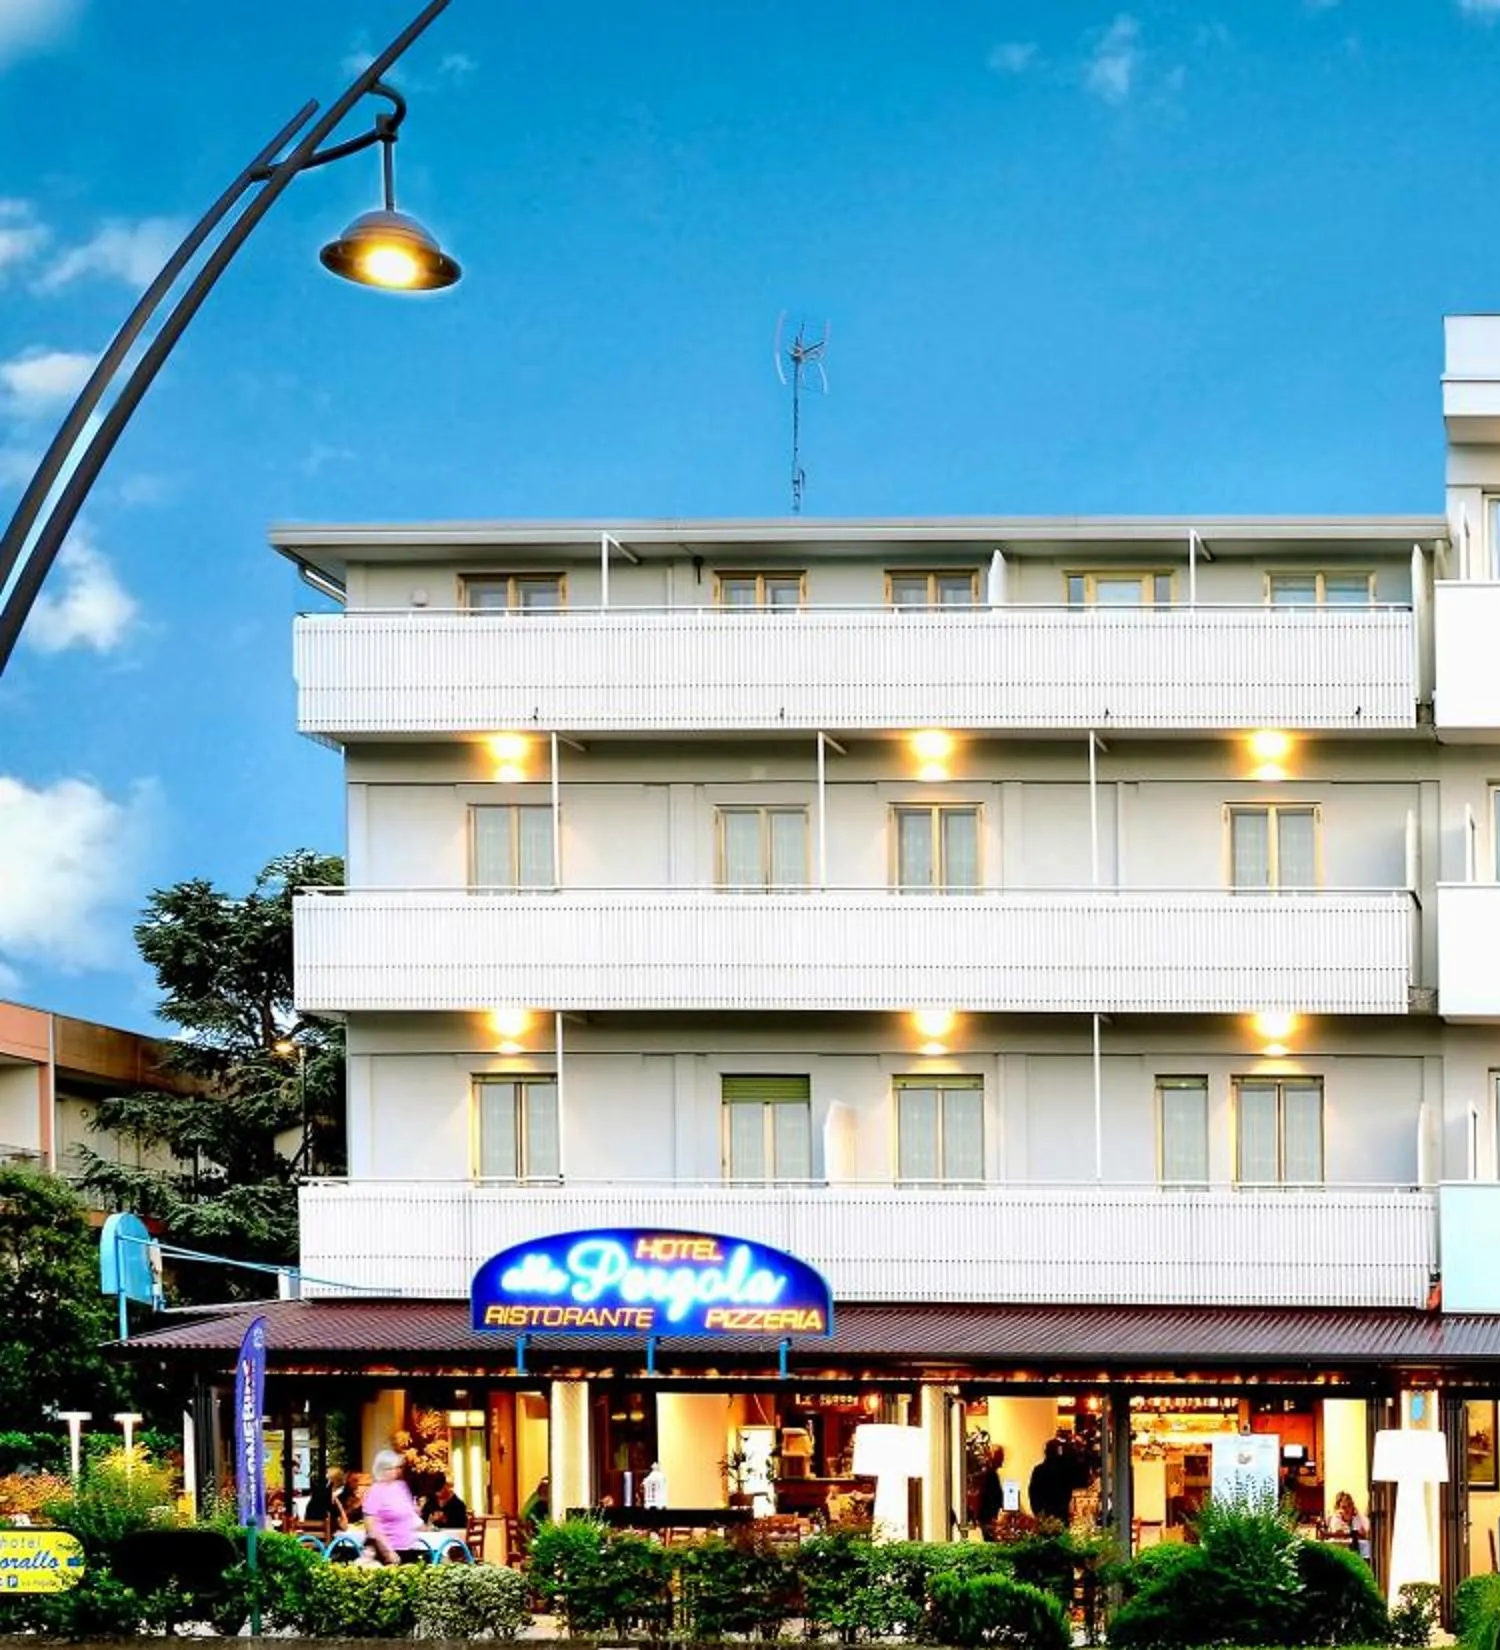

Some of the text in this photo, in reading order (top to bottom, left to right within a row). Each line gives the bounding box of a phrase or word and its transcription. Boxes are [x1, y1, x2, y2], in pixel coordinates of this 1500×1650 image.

[636, 1237, 725, 1262] HOTEL
[567, 1238, 788, 1322] Pergola
[484, 1304, 823, 1331] RISTORANTE PIZZERIA
[0, 1549, 59, 1569] orallo
